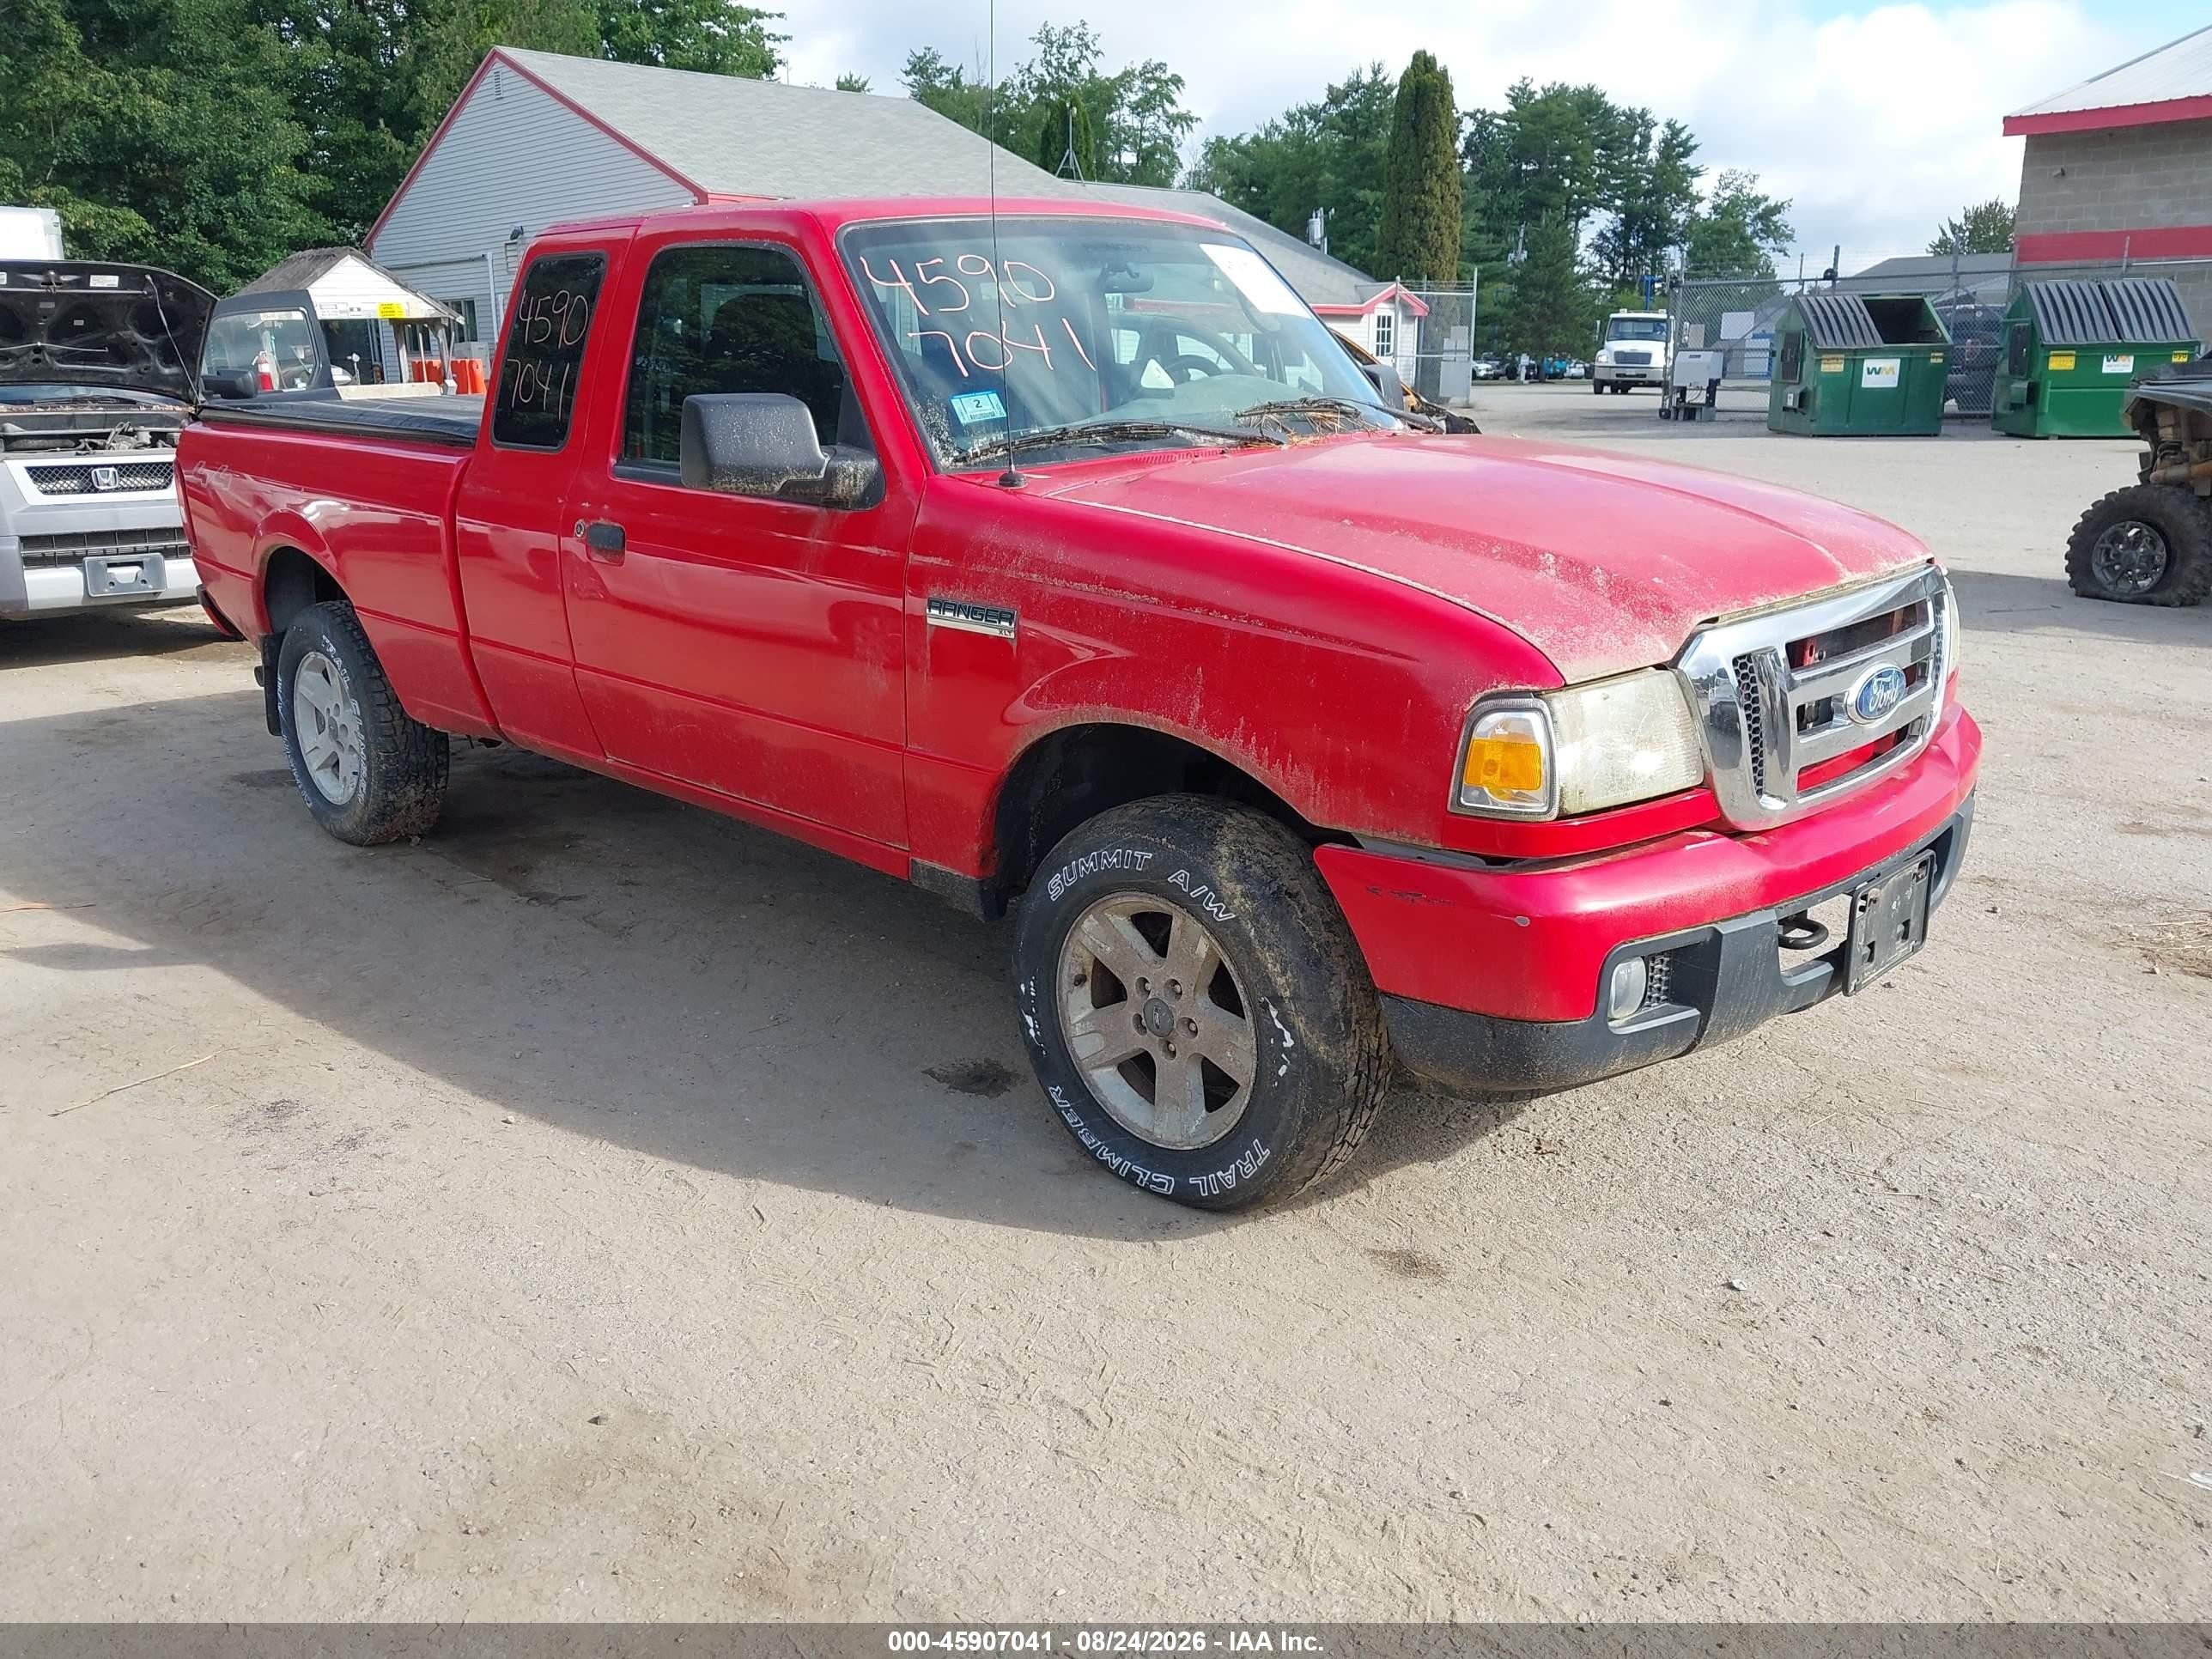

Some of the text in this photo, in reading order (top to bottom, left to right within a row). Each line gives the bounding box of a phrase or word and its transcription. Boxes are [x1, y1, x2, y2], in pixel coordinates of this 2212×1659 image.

[859, 253, 1055, 316] 4590
[519, 289, 589, 349] 4590
[906, 317, 1097, 378] 7041
[507, 358, 570, 422] 7041
[1867, 366, 1896, 375] WM
[973, 398, 983, 409] 2
[927, 598, 1017, 627] RANGER
[998, 628, 1014, 637] XLT
[1869, 669, 1900, 713] Ford
[1048, 849, 1237, 922] SUMMIT A/W
[1048, 1085, 1271, 1196] TRAIL CLIMBER
